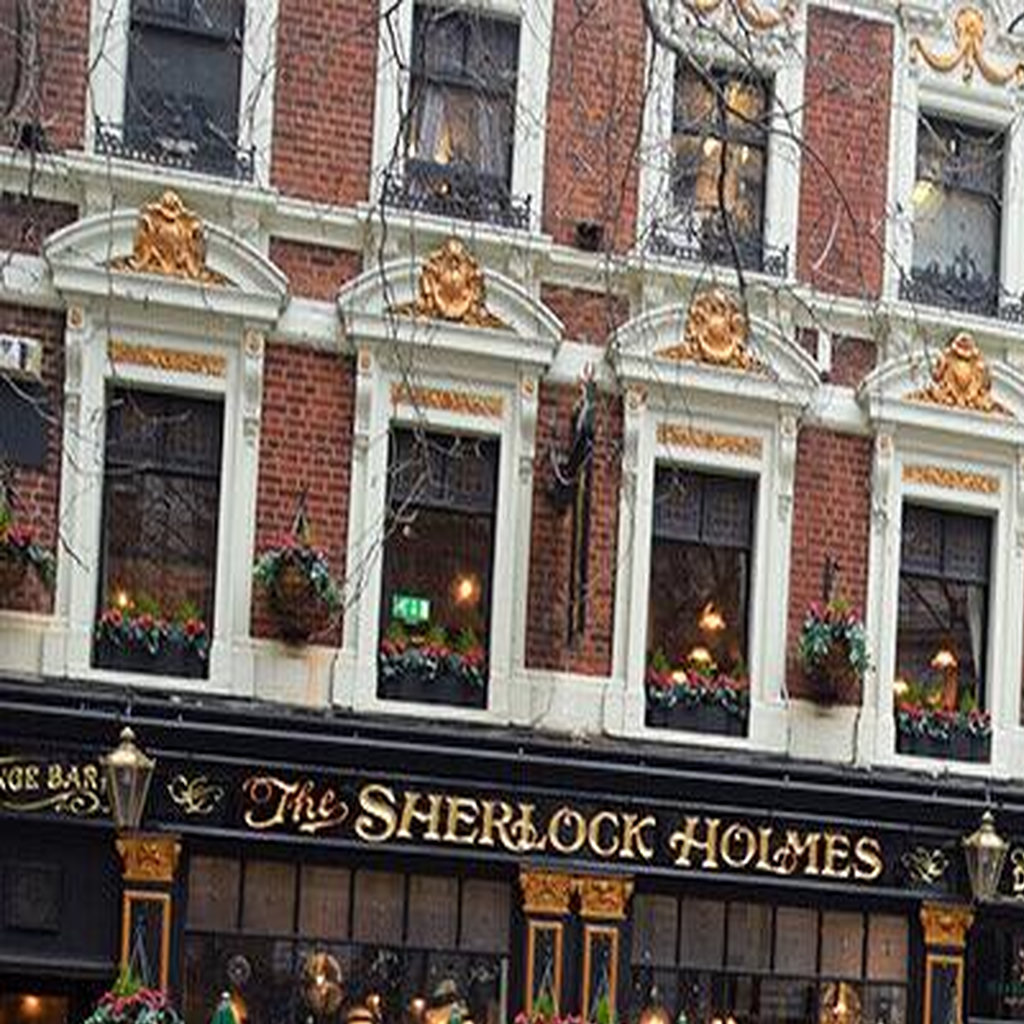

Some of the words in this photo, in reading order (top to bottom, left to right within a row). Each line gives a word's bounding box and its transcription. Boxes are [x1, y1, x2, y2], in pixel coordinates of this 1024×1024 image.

[47, 763, 98, 790] BAR
[242, 777, 349, 832] The
[354, 784, 657, 859] SHERLOCK
[668, 816, 885, 881] HOLMES
